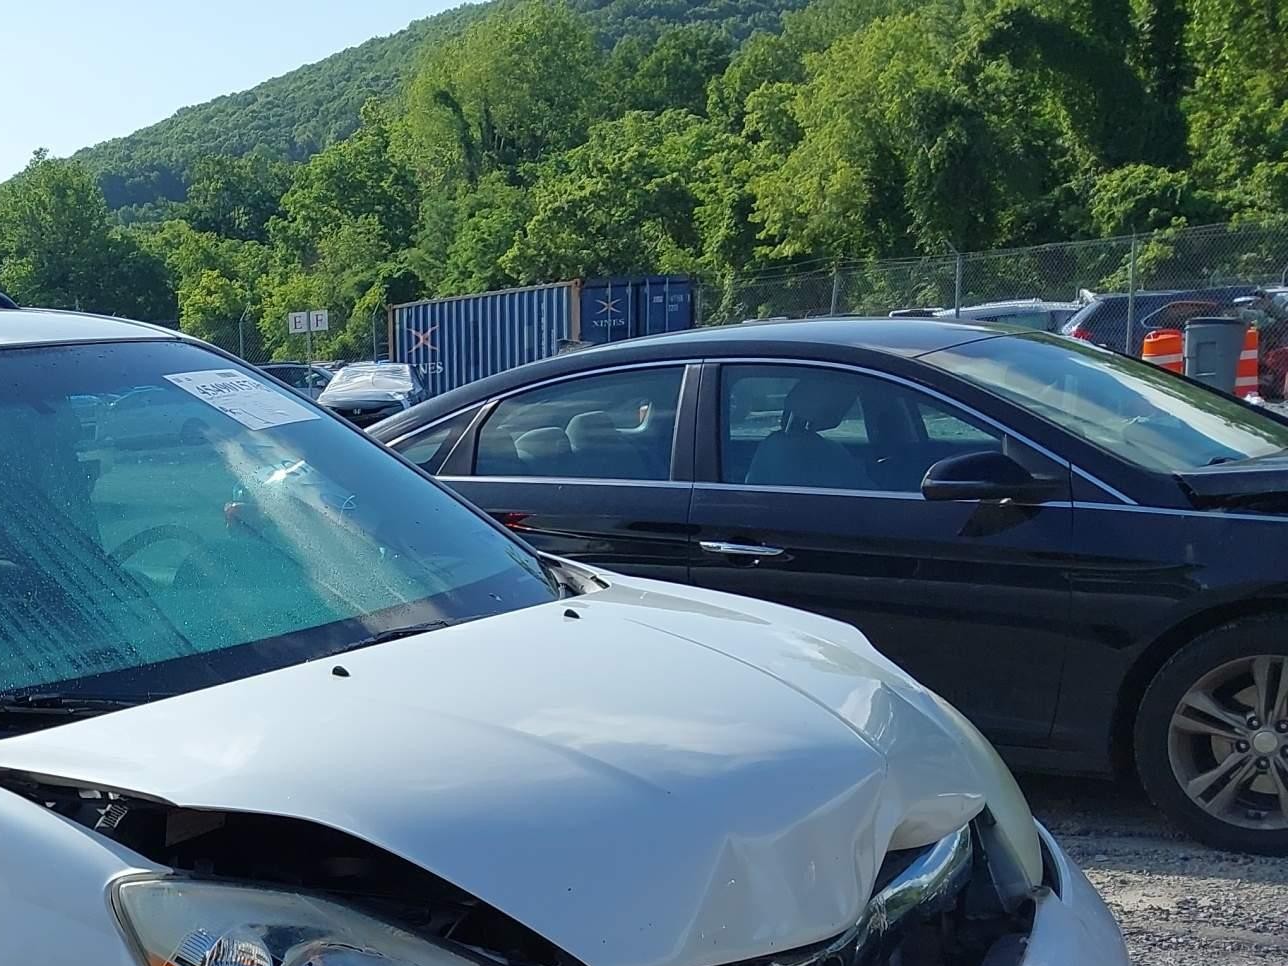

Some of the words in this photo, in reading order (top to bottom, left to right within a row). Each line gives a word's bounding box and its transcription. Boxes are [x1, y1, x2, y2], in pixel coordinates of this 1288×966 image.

[294, 315, 303, 330] E
[315, 313, 324, 328] F
[416, 361, 444, 374] NES
